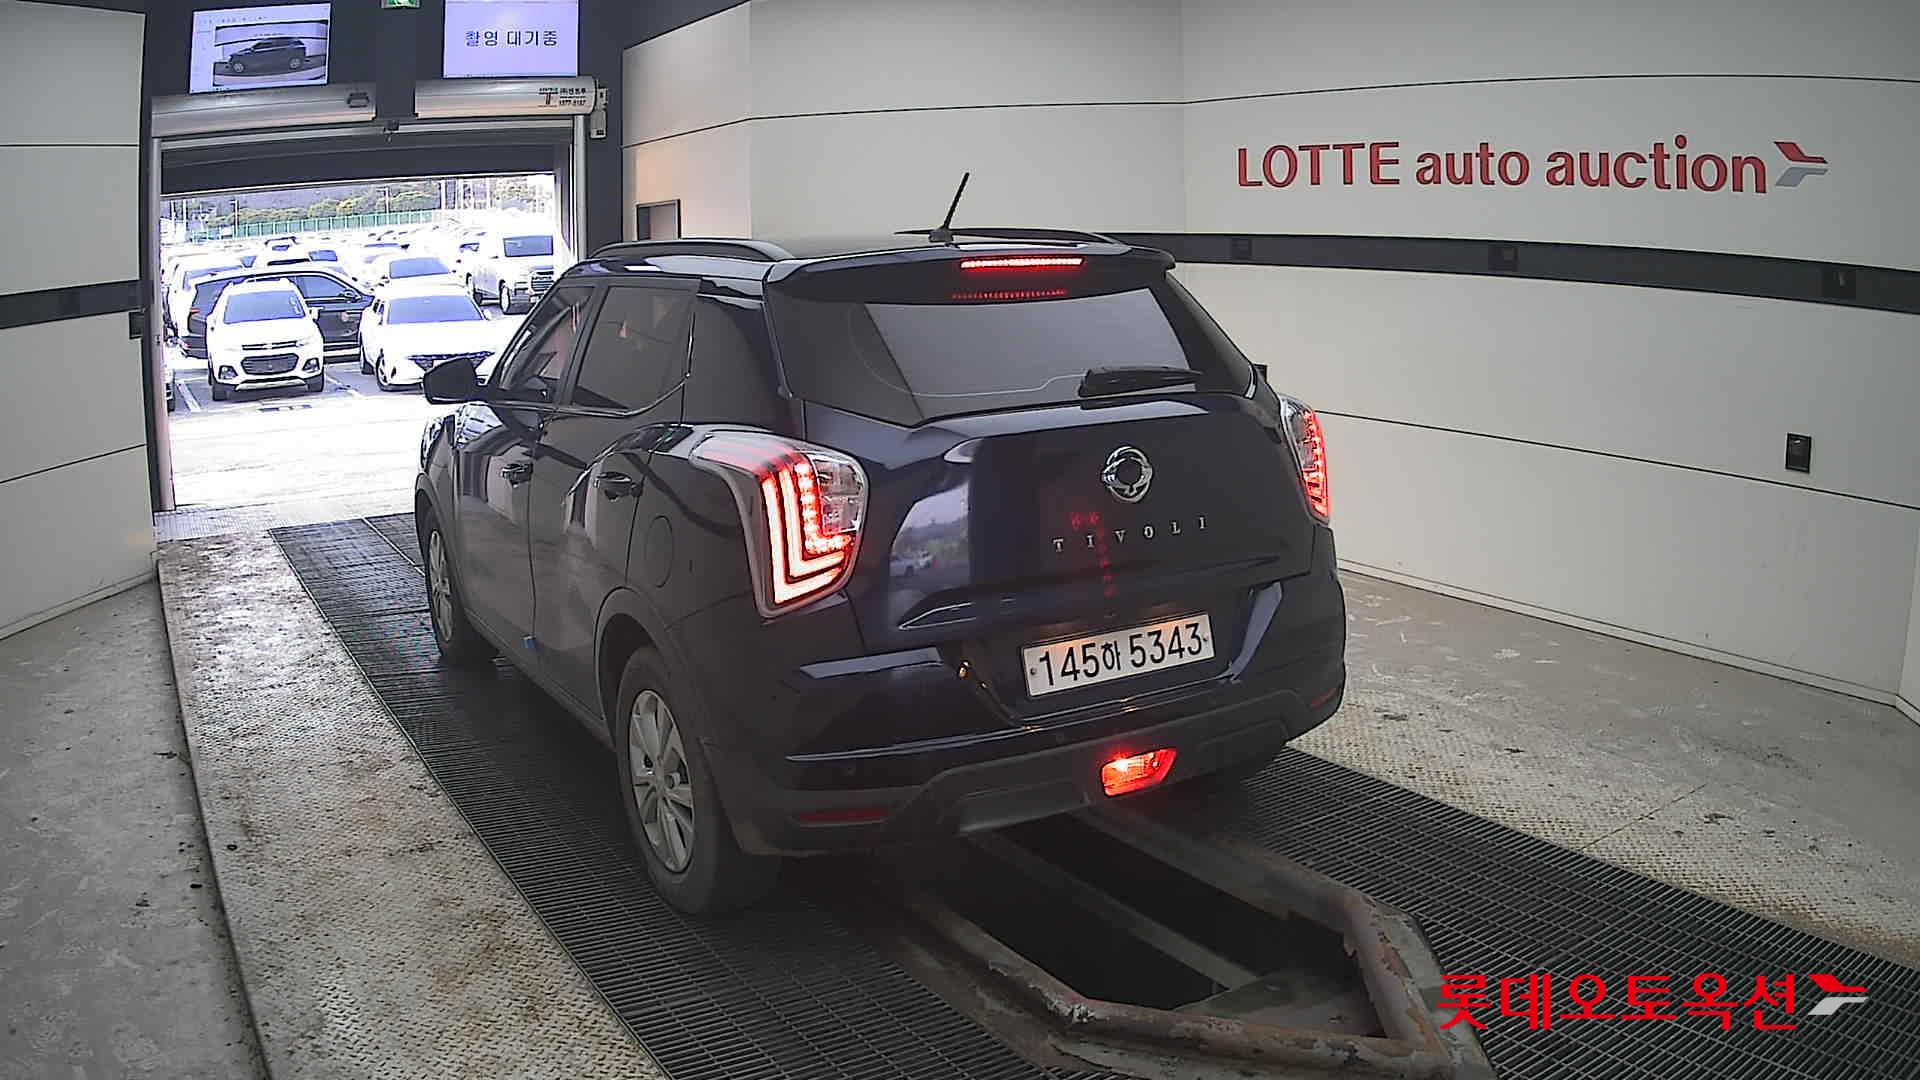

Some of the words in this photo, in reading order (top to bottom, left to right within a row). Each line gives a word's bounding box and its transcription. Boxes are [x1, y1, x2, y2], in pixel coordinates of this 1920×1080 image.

[466, 31, 497, 47] 촬영
[507, 31, 557, 46] 대기중
[1238, 141, 1401, 187] LOTTE
[1415, 142, 1531, 186] auto
[1546, 134, 1768, 193] auction
[1052, 515, 1207, 553] TIVOLI
[1039, 640, 1122, 686] 145하
[1129, 622, 1203, 667] 5343
